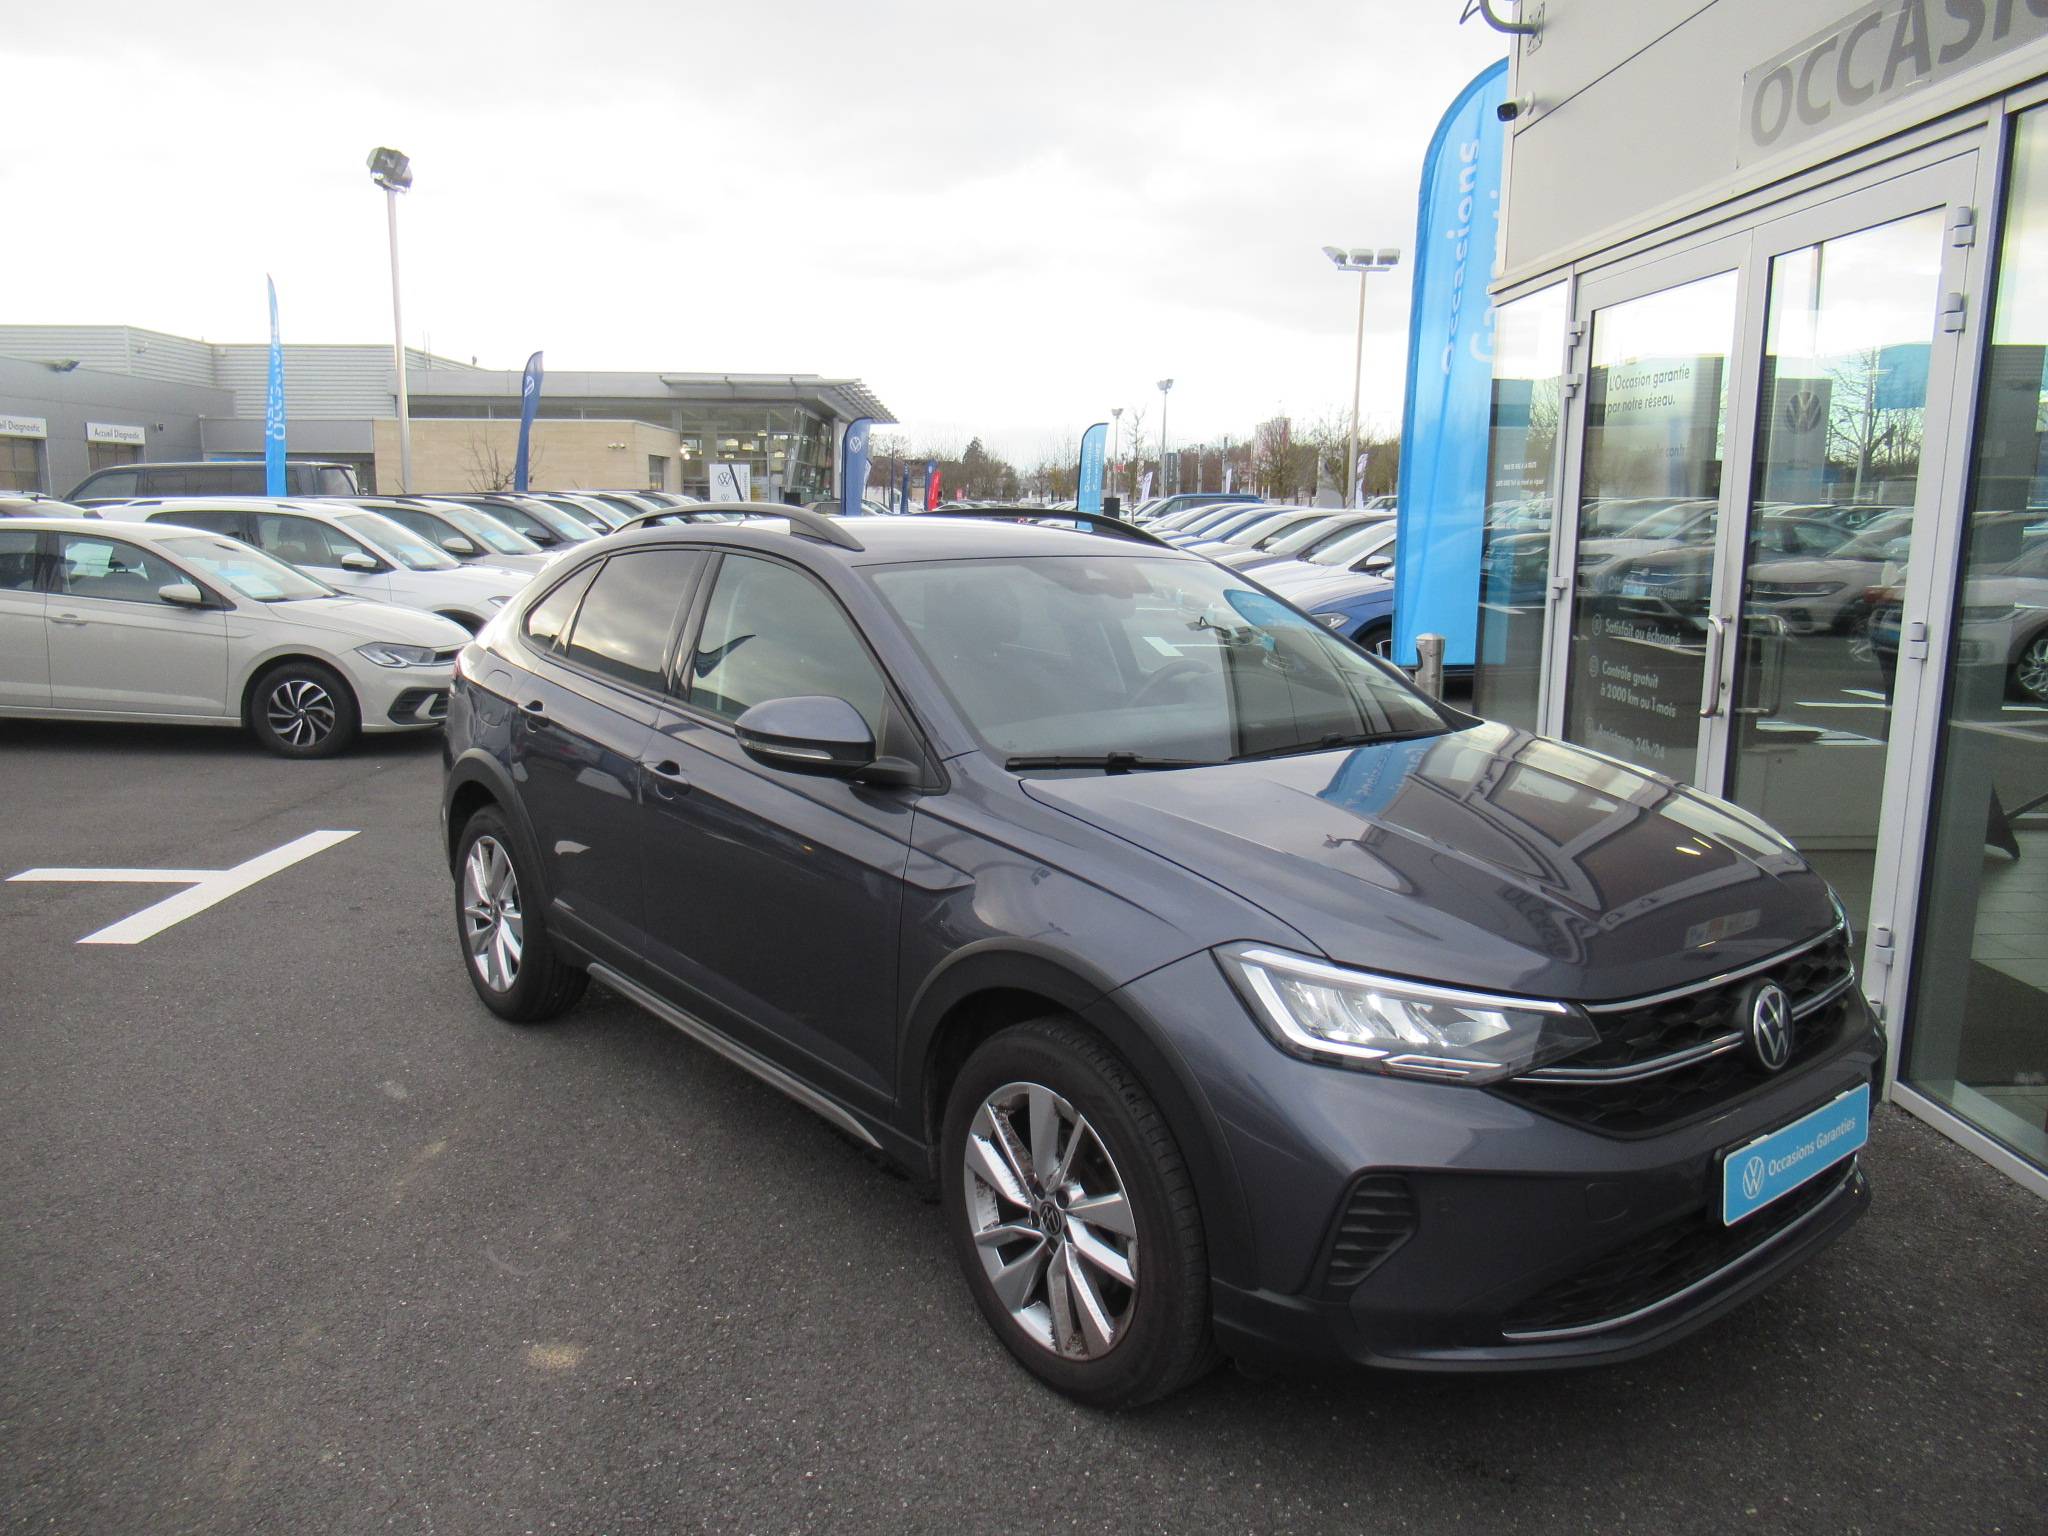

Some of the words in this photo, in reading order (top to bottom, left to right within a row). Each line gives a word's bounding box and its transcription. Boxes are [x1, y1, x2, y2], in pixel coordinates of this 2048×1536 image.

[1750, 0, 2048, 147] OCCAS
[1441, 138, 1480, 375] Occasions
[1609, 372, 1651, 391] L'Occasion
[1653, 363, 1690, 388] garantie
[1607, 402, 1620, 417] par
[1622, 396, 1643, 412] notre
[1605, 619, 1633, 639] Satisfait
[1635, 630, 1645, 639] ou
[1646, 627, 1680, 646] échangé
[1602, 661, 1631, 680] Contrôle
[1633, 674, 1658, 688] gratuit
[1600, 683, 1605, 696] à
[1607, 683, 1626, 702] 2000
[1628, 692, 1638, 706] km
[1640, 699, 1650, 709] ou
[1656, 703, 1676, 717] mois
[1768, 1140, 1815, 1176] Occasions
[1816, 1117, 1856, 1150] Garanties
